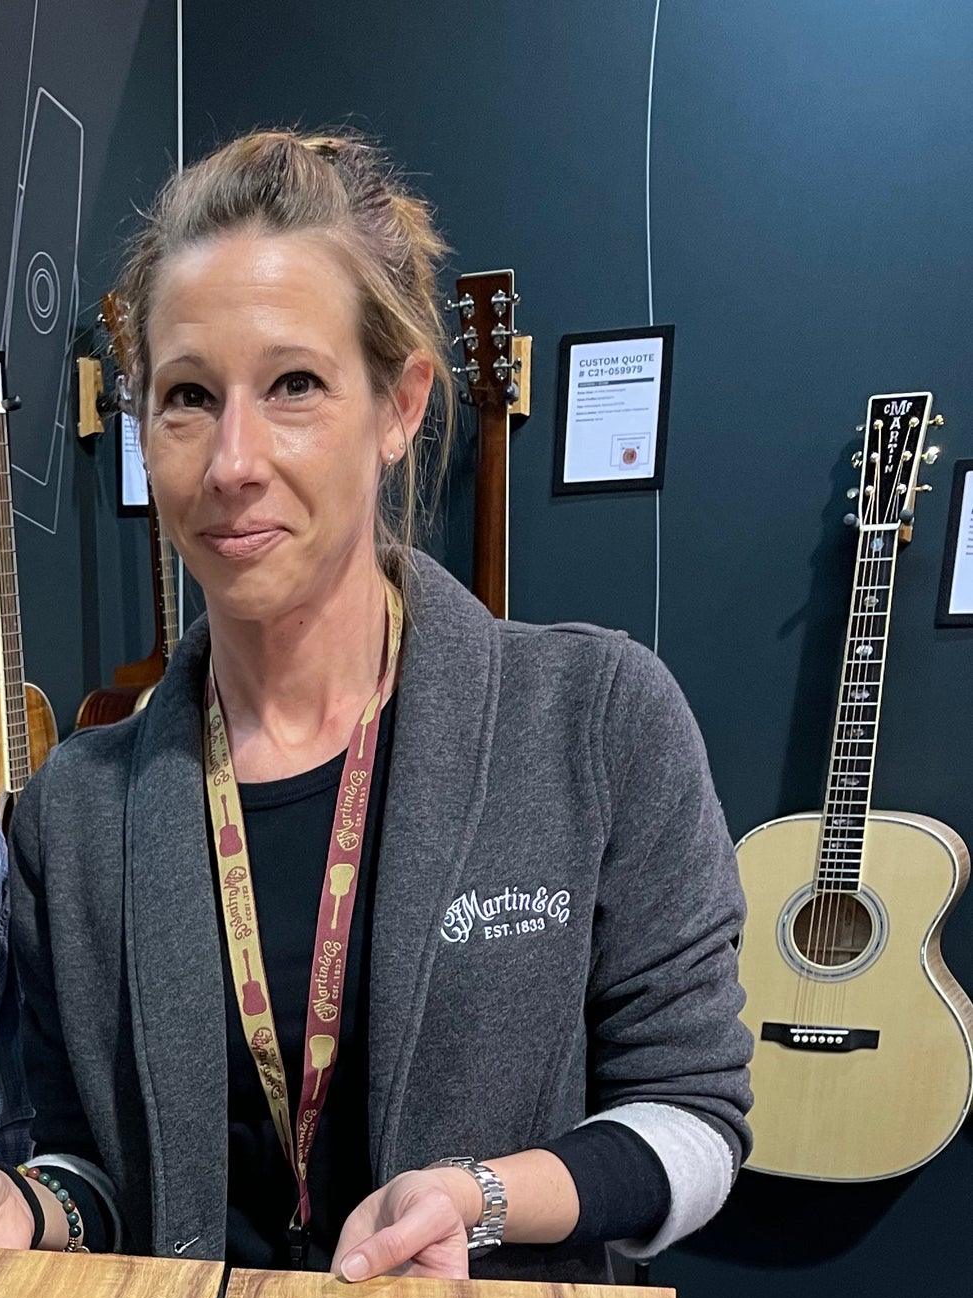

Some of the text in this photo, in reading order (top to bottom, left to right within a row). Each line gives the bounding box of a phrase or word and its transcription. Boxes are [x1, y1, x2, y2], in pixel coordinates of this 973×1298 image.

[579, 353, 655, 368] CUSTOM QUOTE
[578, 365, 643, 378] # C21-059979
[484, 917, 546, 940] EST. 1833
